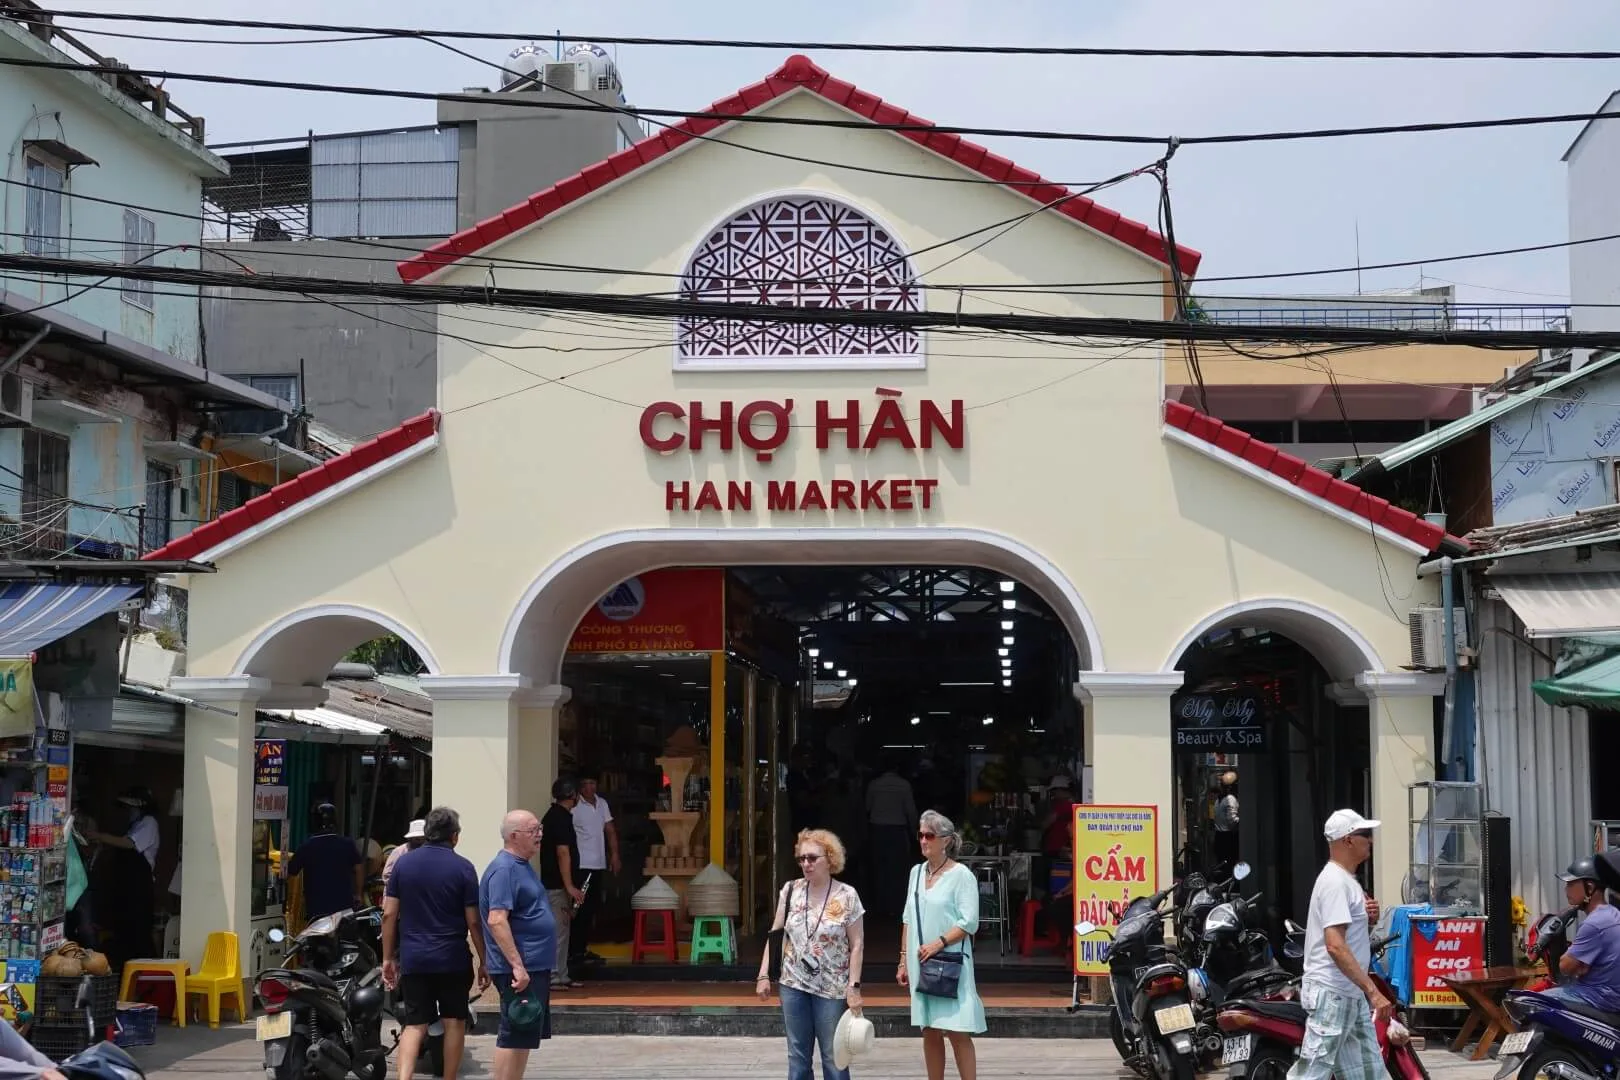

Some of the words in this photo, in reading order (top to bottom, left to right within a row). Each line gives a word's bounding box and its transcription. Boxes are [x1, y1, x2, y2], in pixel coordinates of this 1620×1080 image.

[639, 398, 793, 462] CHỢ
[815, 387, 964, 449] HÀN
[665, 480, 752, 512] HAN
[767, 479, 938, 512] MARKET
[1177, 732, 1222, 747] Beauty
[1225, 730, 1237, 743] &
[1238, 731, 1262, 747] Spa
[1085, 844, 1146, 882] CẤM
[1437, 922, 1476, 933] ANH
[1420, 994, 1434, 1002] 116
[1582, 1029, 1616, 1050] YAMAHA
